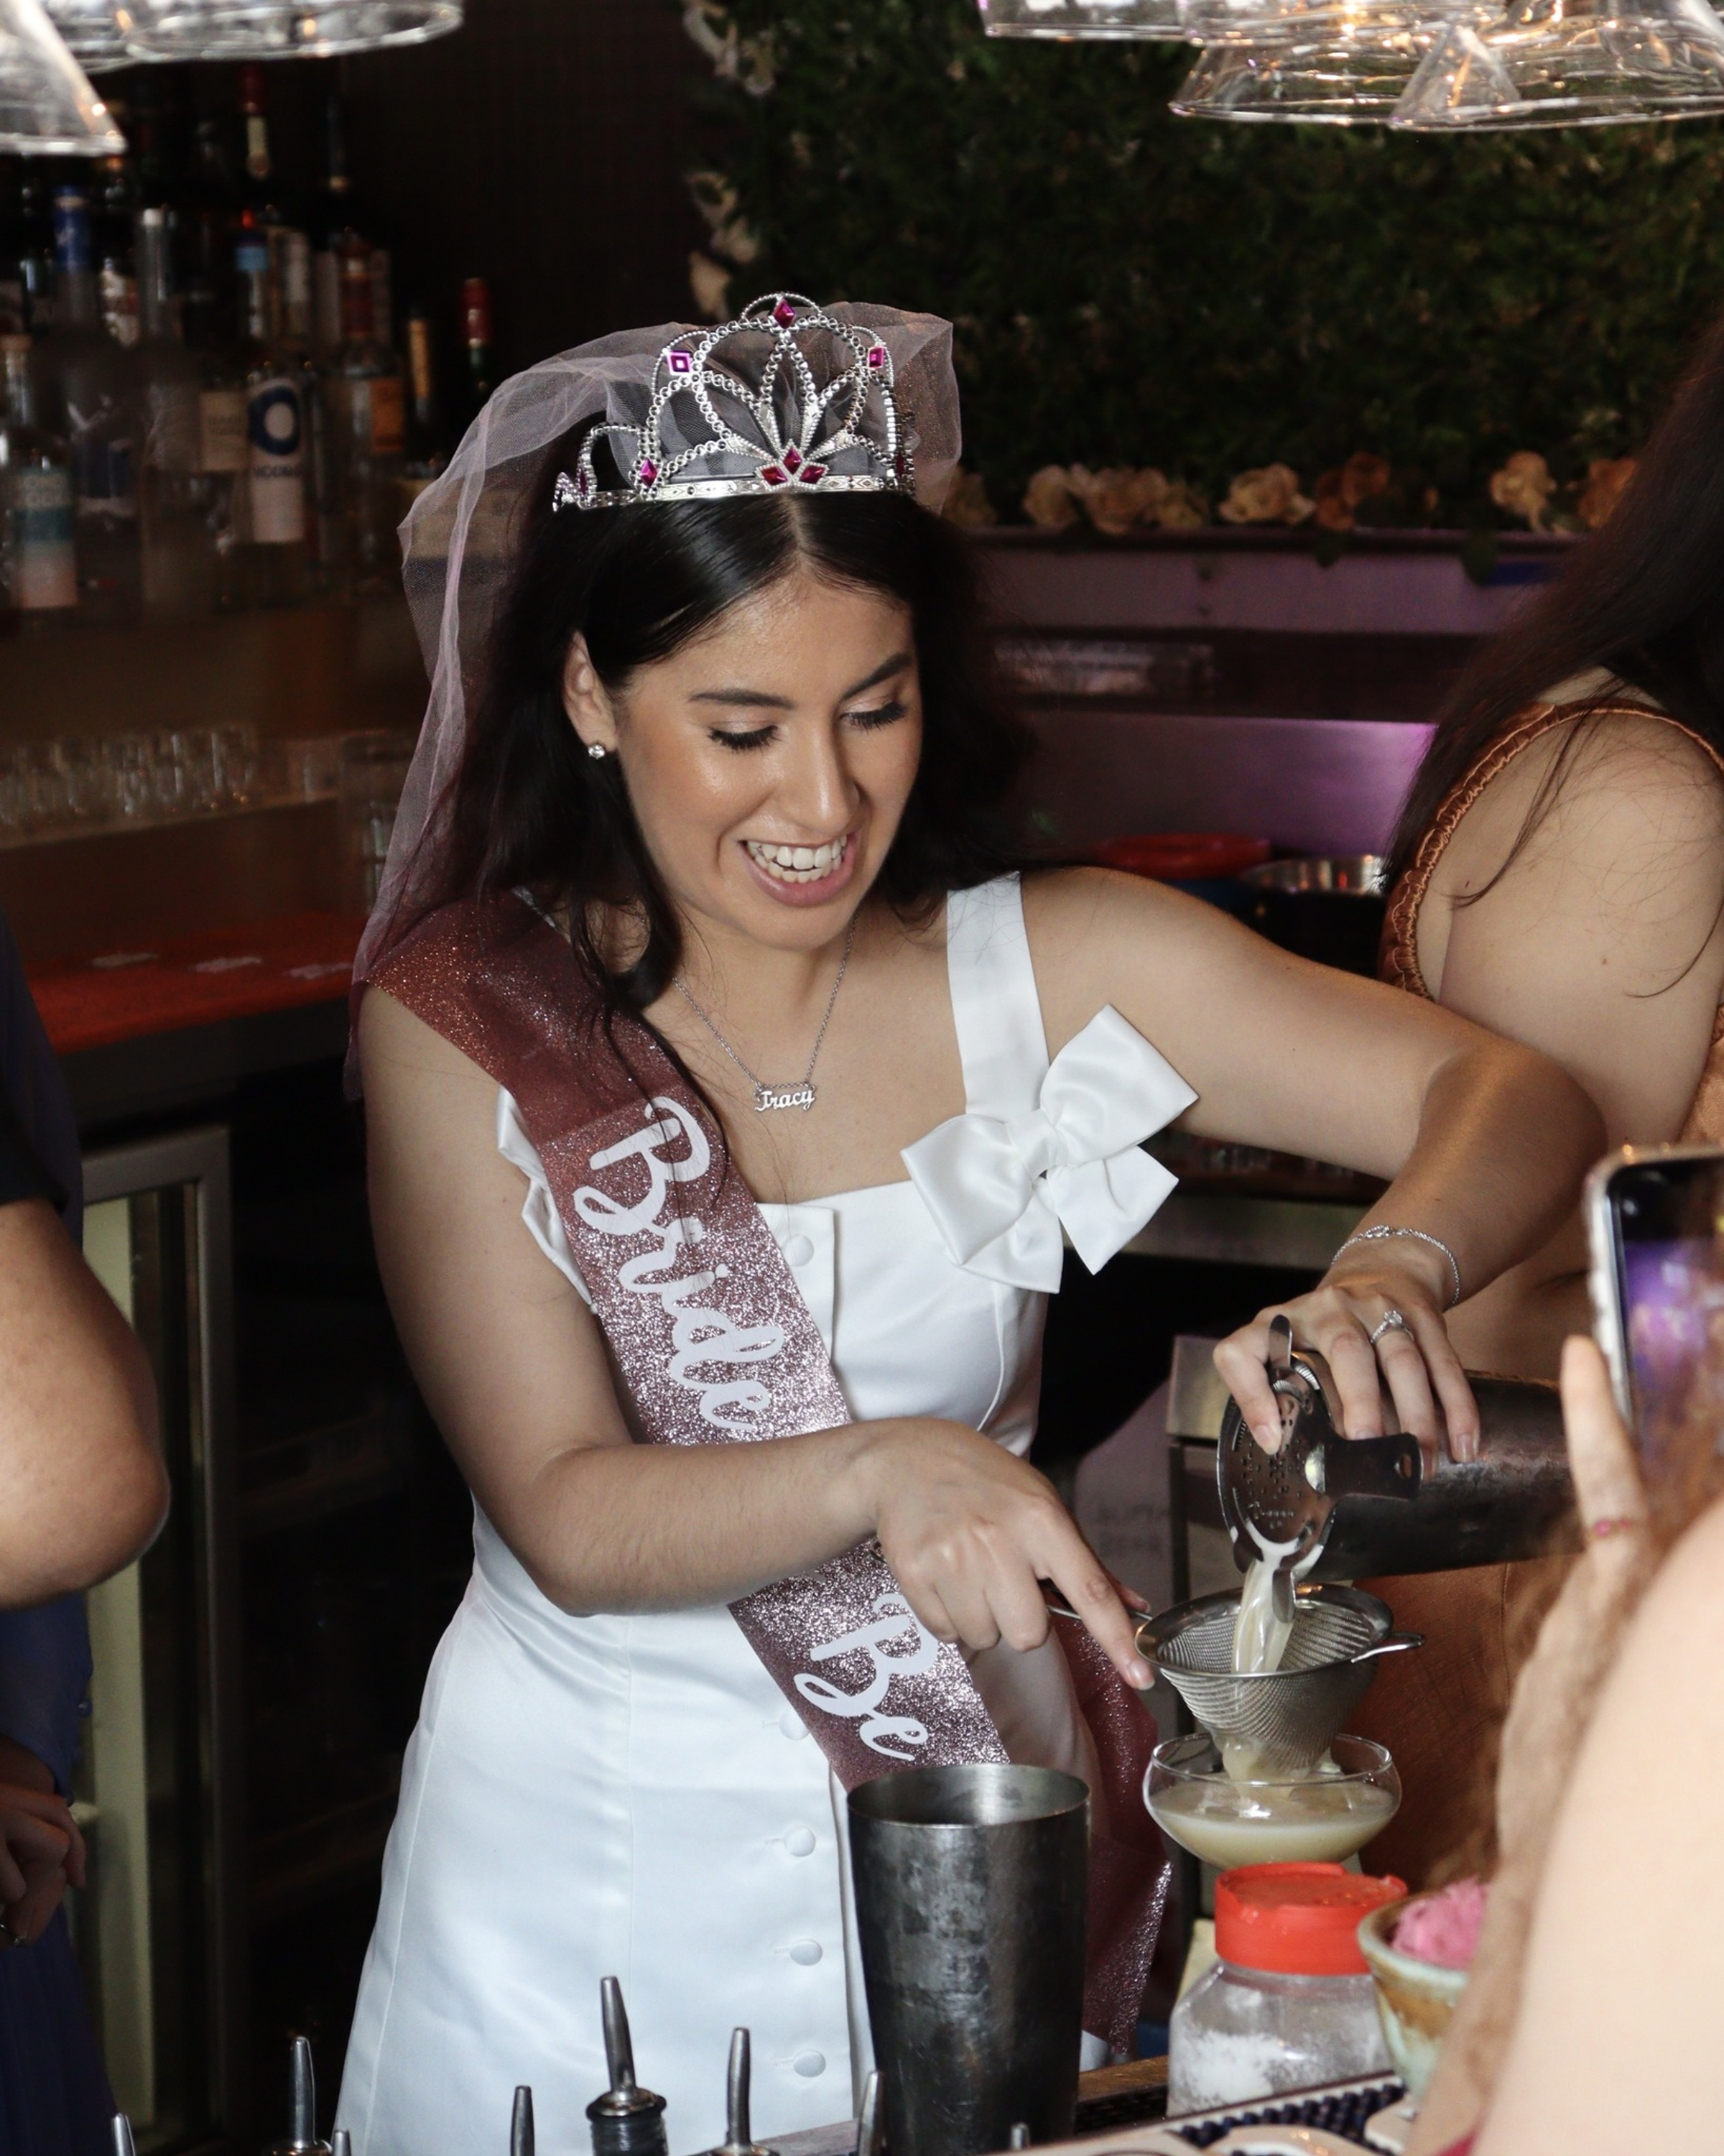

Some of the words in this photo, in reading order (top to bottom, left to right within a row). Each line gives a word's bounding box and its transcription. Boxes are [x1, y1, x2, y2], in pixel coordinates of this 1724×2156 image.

[755, 1089, 815, 1111] Tracy
[573, 1096, 784, 1431] Bride
[793, 1593, 938, 1762] Be
